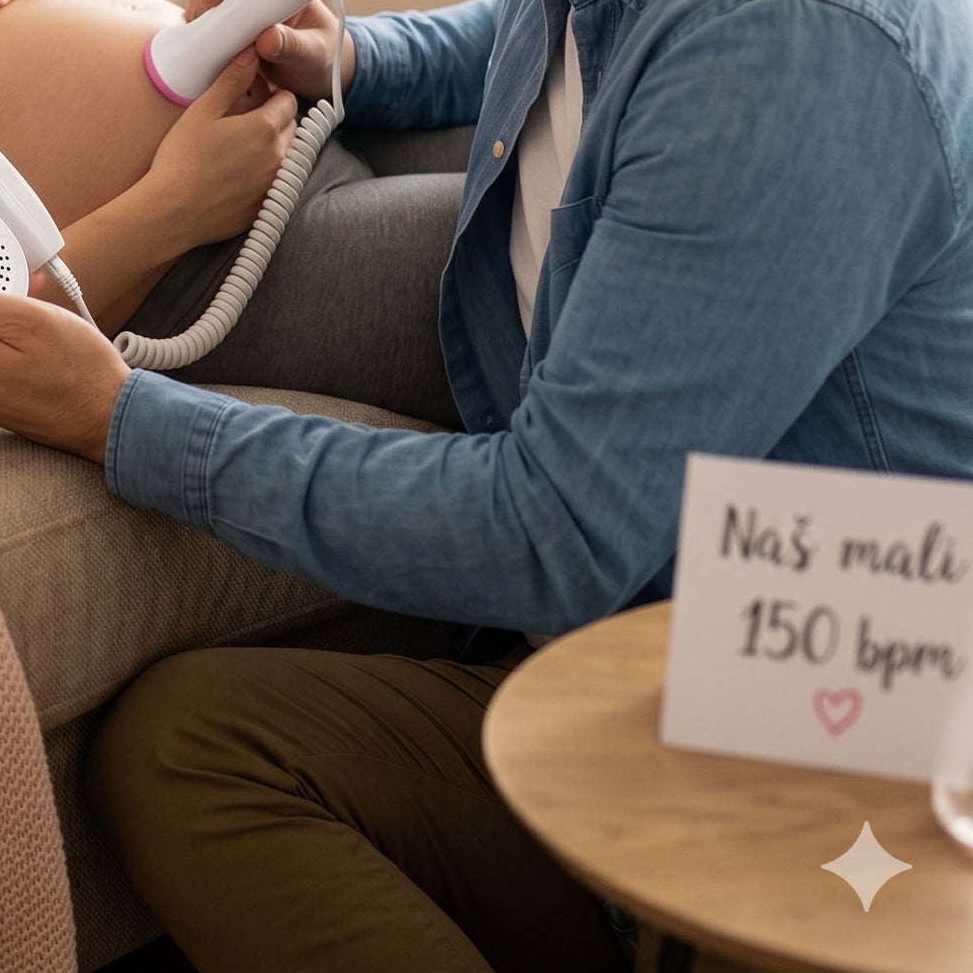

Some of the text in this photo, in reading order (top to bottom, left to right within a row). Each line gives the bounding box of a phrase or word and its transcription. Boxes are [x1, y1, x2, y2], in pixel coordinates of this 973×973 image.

[718, 503, 969, 584] Naš mali
[738, 597, 967, 694] 150 bpm
